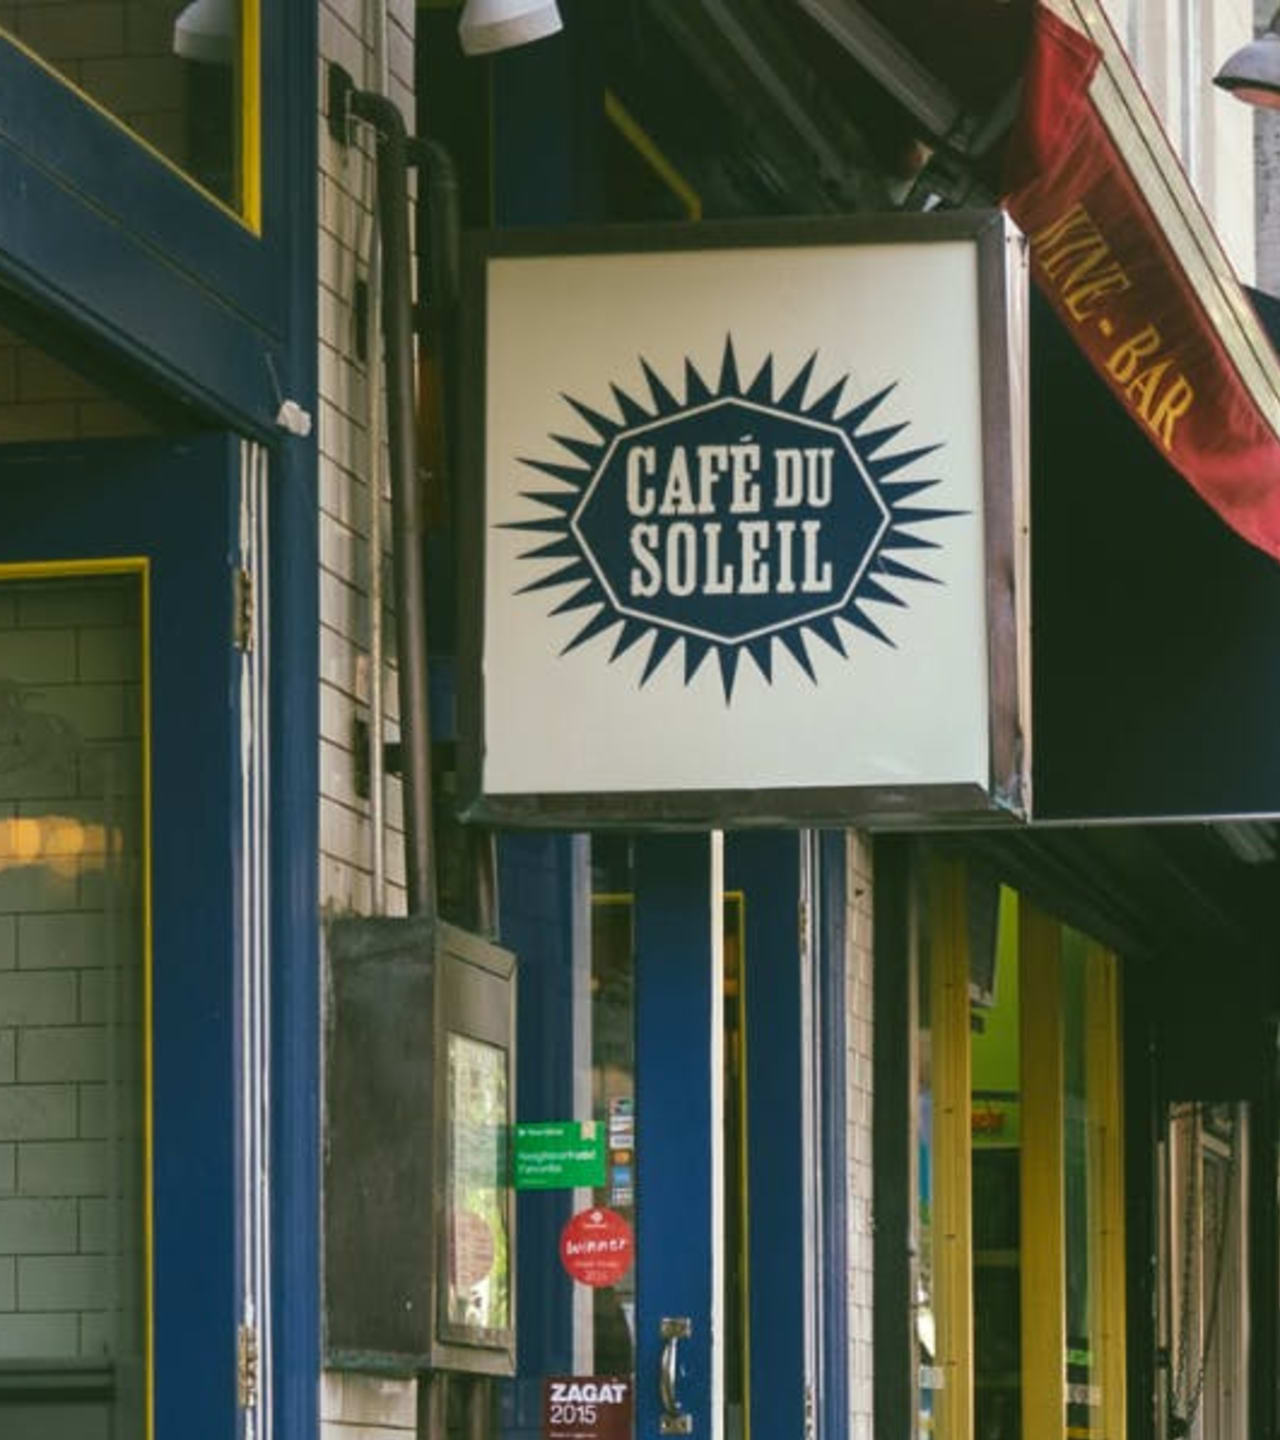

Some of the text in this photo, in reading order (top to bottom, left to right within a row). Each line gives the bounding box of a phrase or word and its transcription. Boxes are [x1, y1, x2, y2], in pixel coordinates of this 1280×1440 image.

[1107, 324, 1194, 452] BAR
[626, 434, 835, 517] CAFÉ DU
[629, 519, 833, 598] SOLEIL
[549, 1382, 628, 1404] ZAGAT
[549, 1404, 598, 1425] 2015
